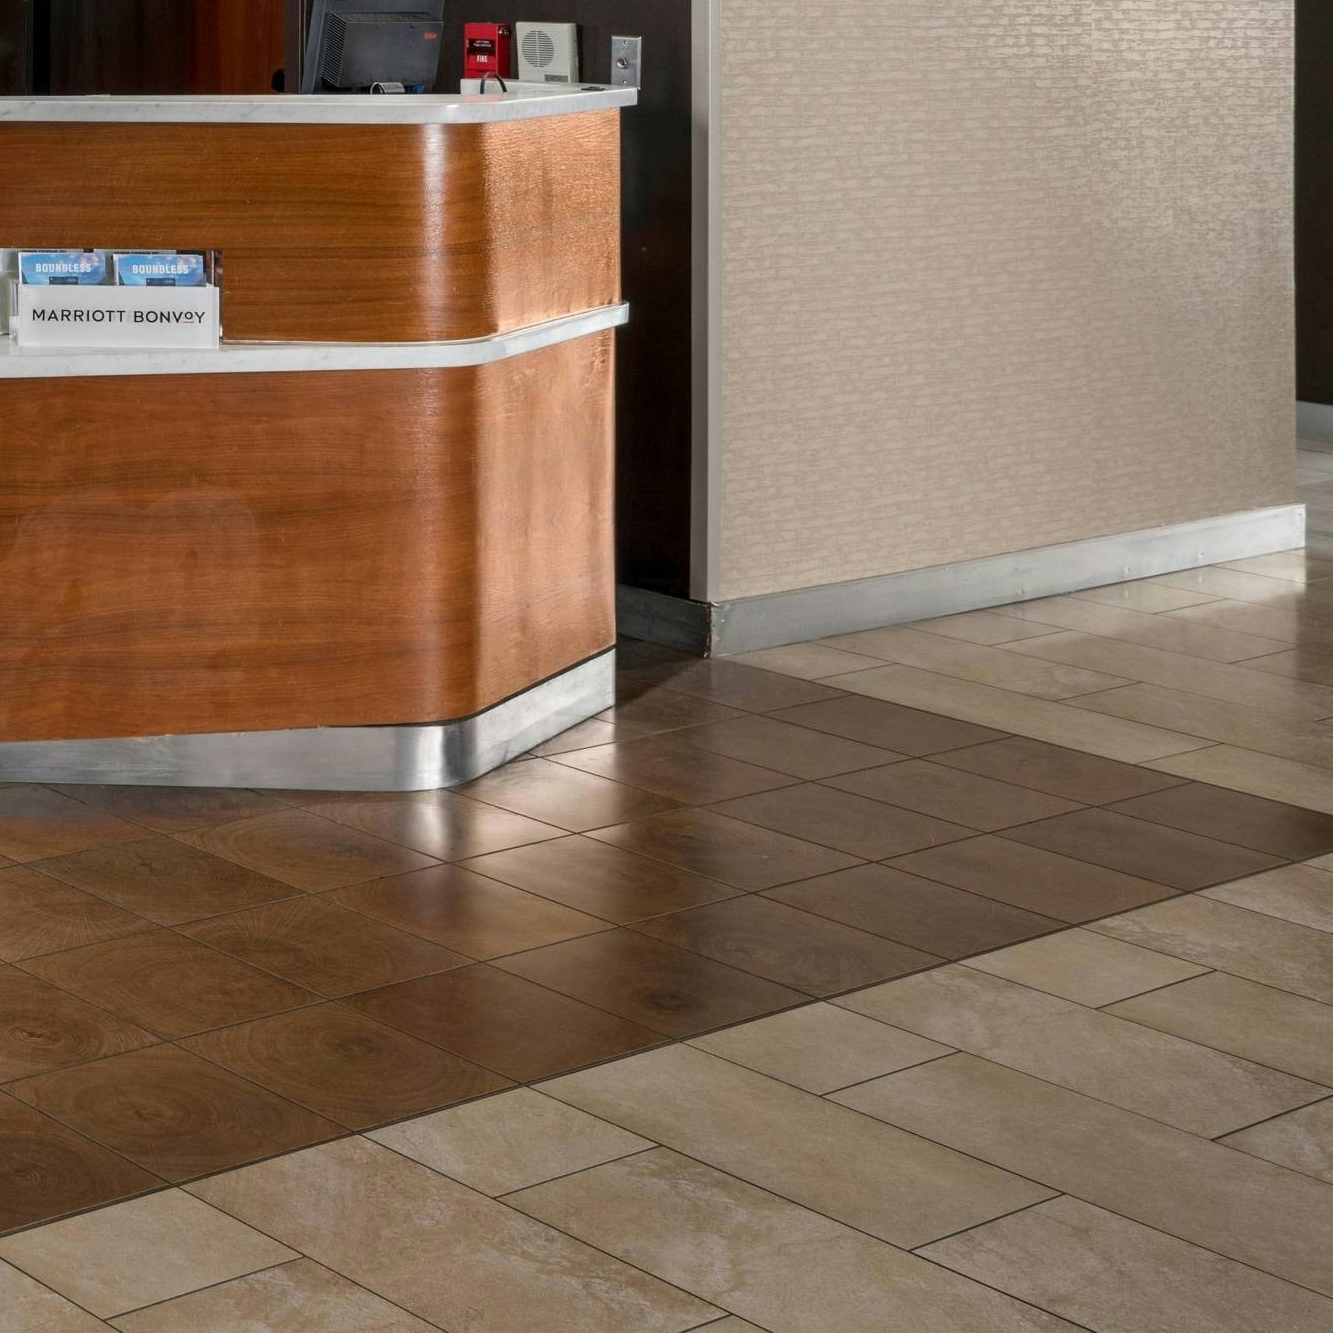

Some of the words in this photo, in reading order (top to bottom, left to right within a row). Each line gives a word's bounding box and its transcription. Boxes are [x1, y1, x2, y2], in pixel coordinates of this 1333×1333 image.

[476, 54, 488, 63] FIRE
[36, 263, 91, 273] BOUNDLESS
[132, 264, 189, 275] BOUNDLESS
[32, 309, 126, 323] MARRIOTT
[134, 310, 205, 324] BONVOY
